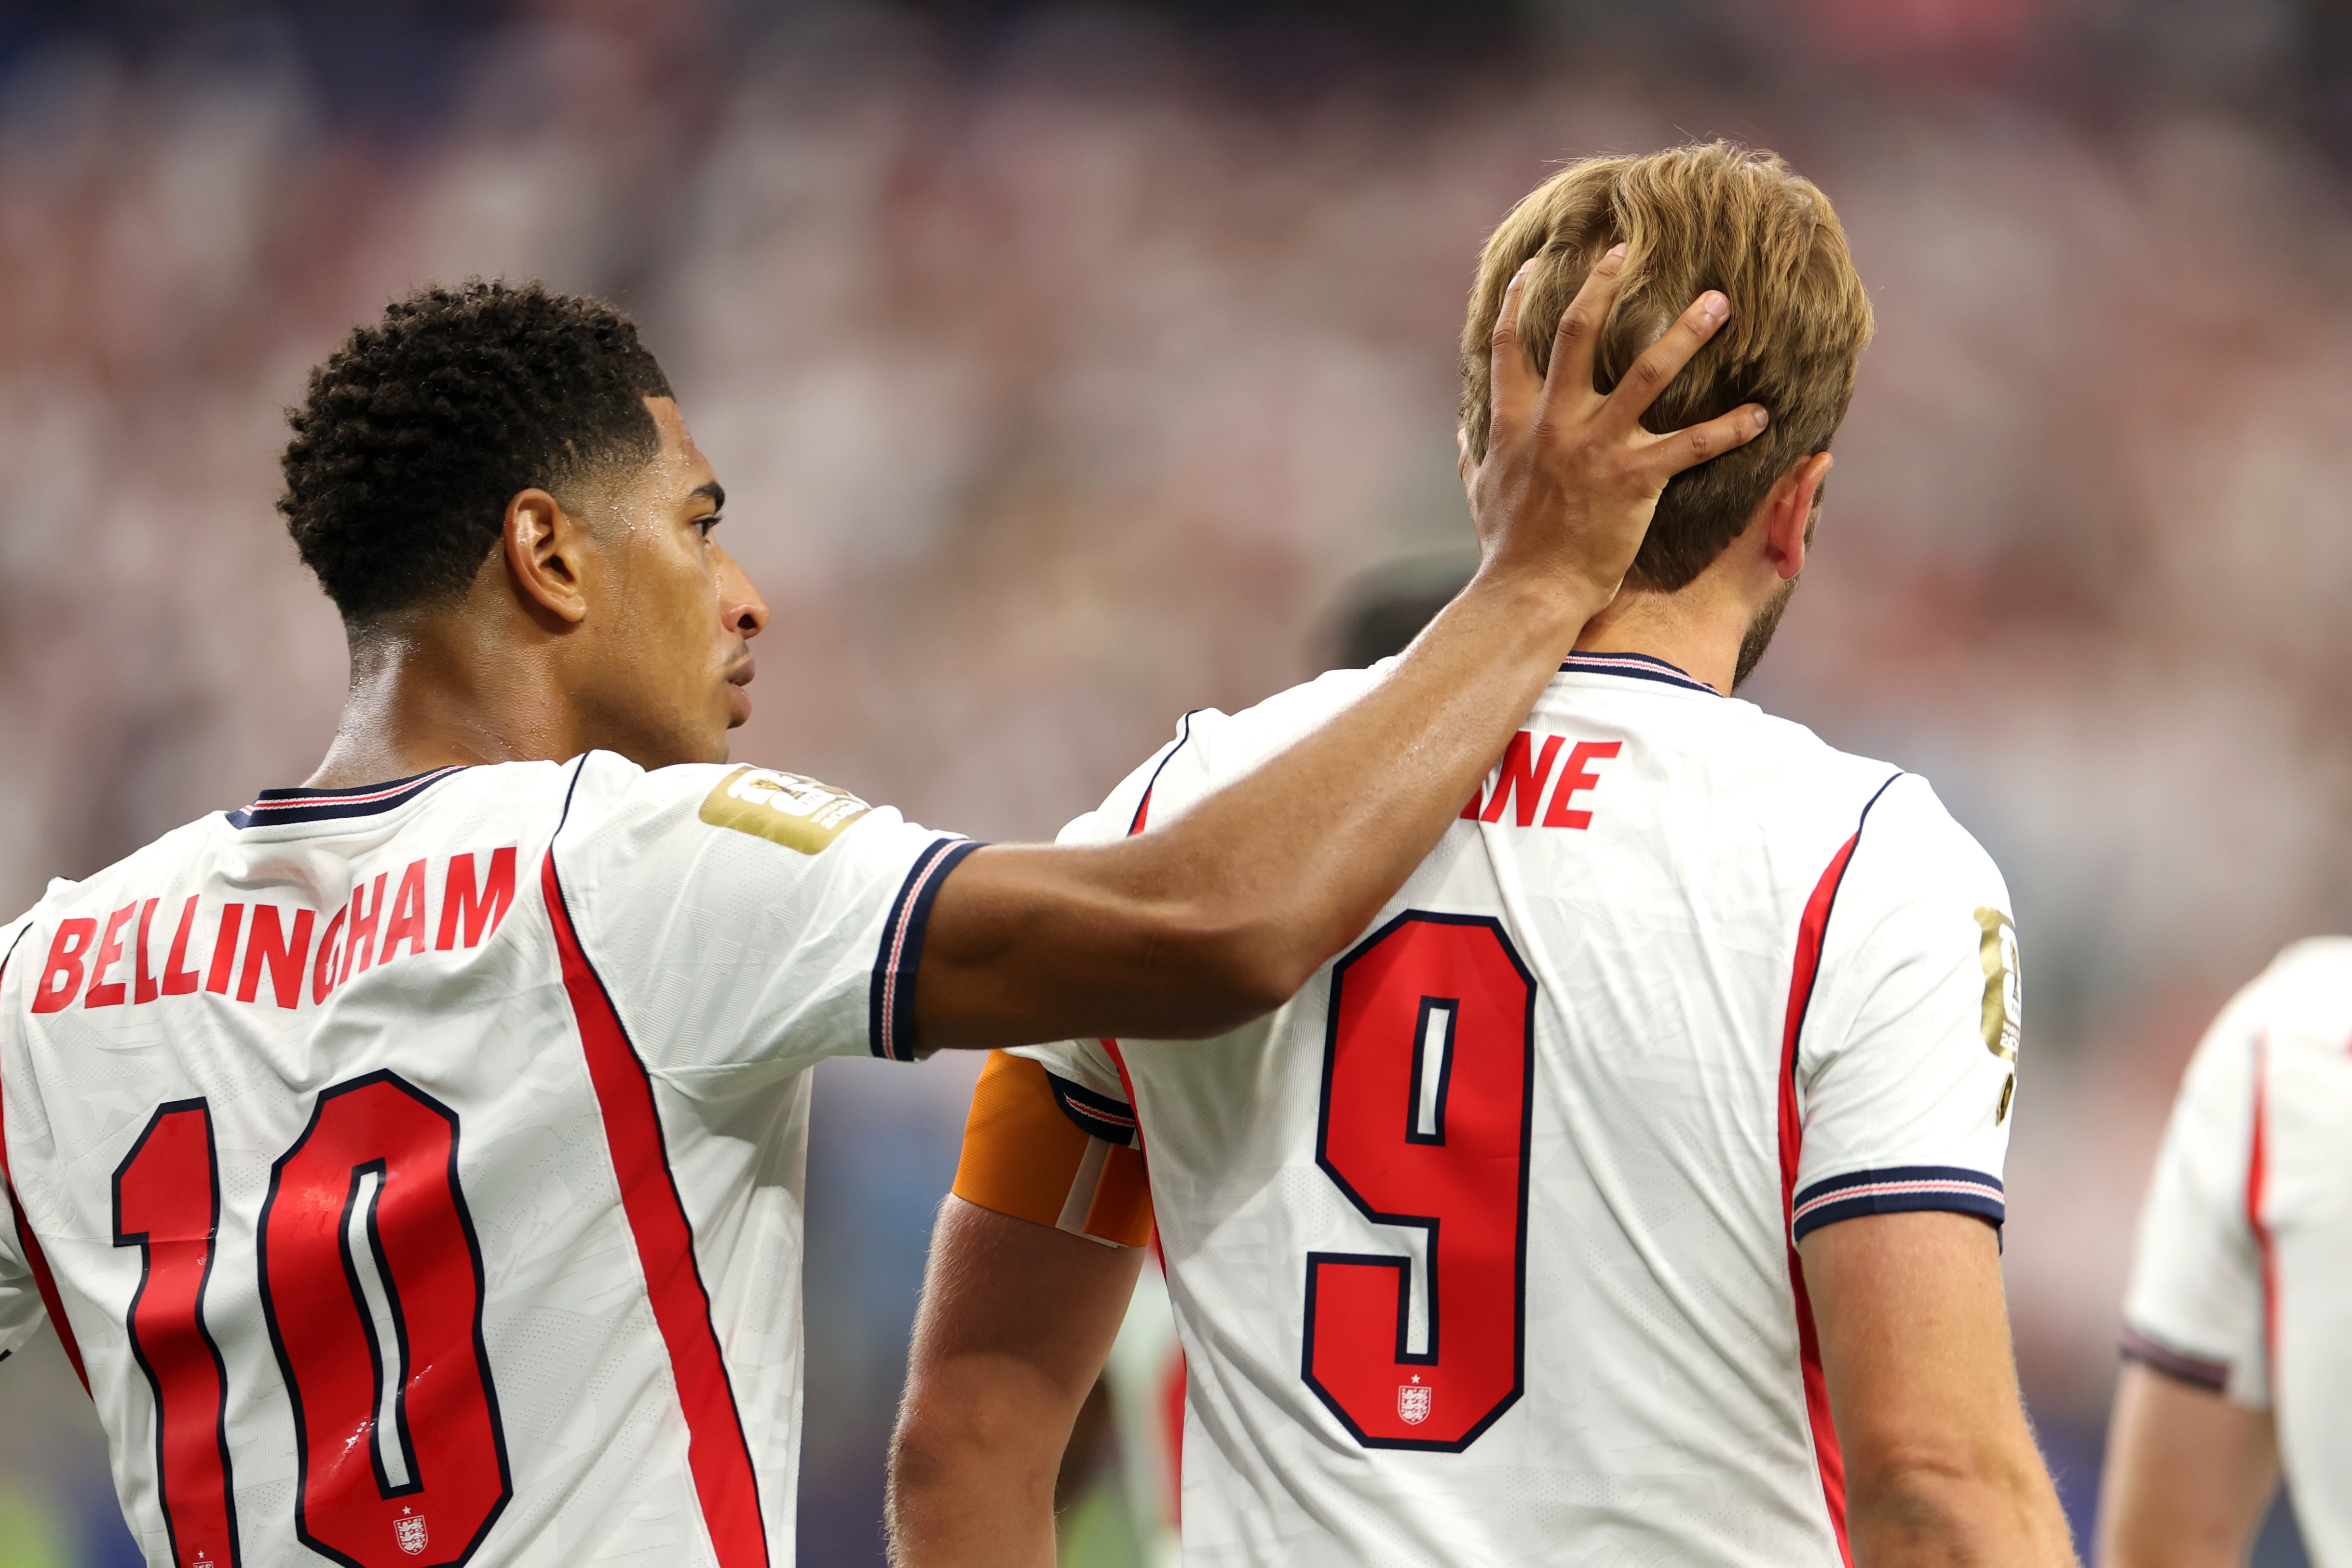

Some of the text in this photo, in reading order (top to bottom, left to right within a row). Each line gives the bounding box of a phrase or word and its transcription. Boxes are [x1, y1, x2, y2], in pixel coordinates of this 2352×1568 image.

[31, 847, 517, 1014] BELLINGHAM
[1460, 730, 1623, 830] NE
[112, 1068, 514, 1568] 10
[1301, 908, 1537, 1453] 9
